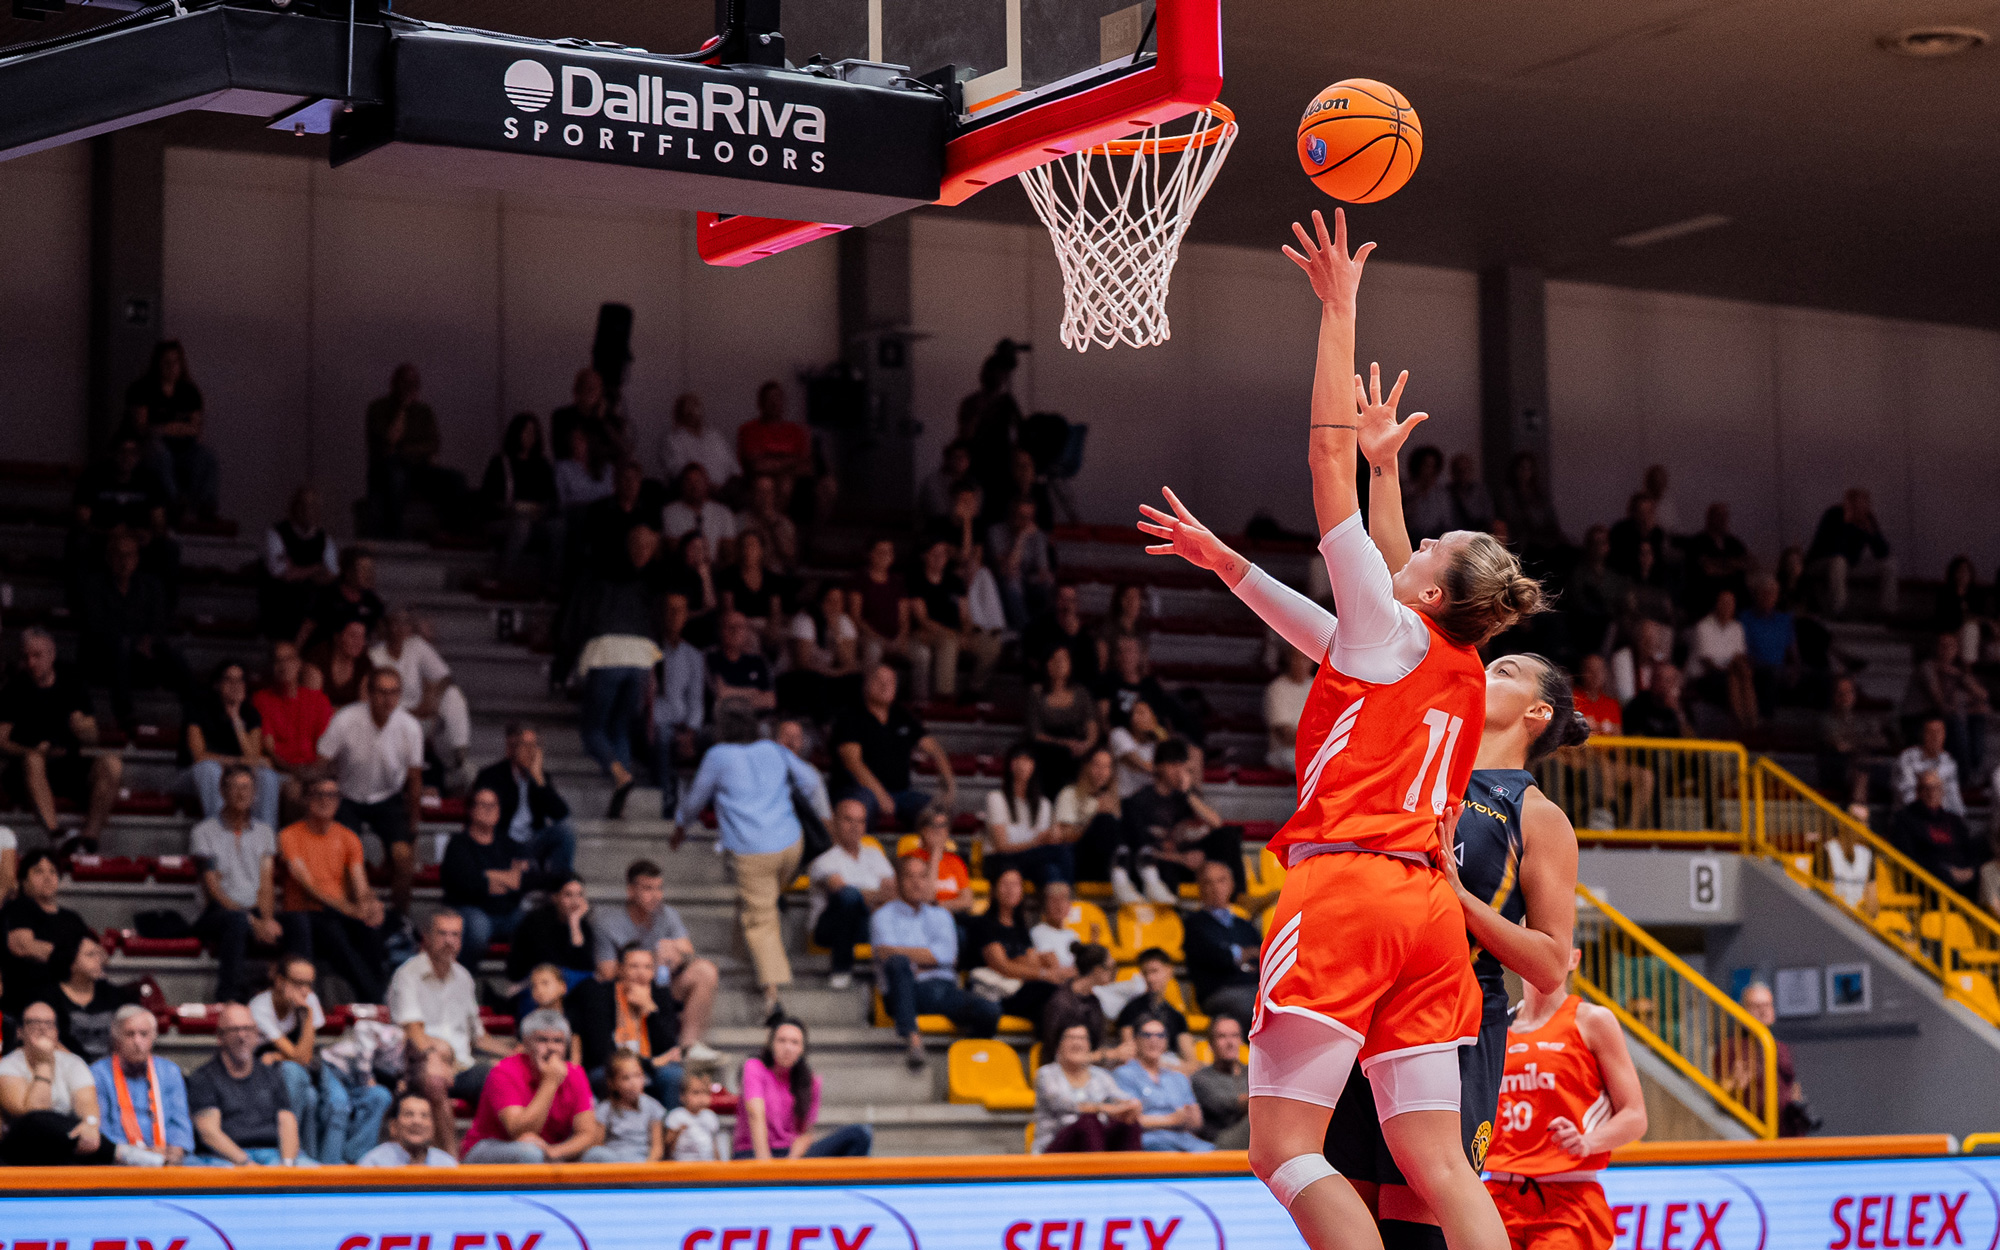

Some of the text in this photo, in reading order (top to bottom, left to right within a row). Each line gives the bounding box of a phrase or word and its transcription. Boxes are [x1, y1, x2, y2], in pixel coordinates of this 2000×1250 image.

[561, 65, 827, 144] DallaRiva
[1302, 98, 1350, 119] ilson
[503, 116, 826, 174] SPORTFLOORS
[1402, 707, 1464, 815] 11
[1696, 865, 1714, 904] B
[1500, 1062, 1556, 1094] mila
[1502, 1100, 1533, 1133] 30
[1612, 1201, 1731, 1250] ELEX
[1830, 1192, 1970, 1250] SELEX
